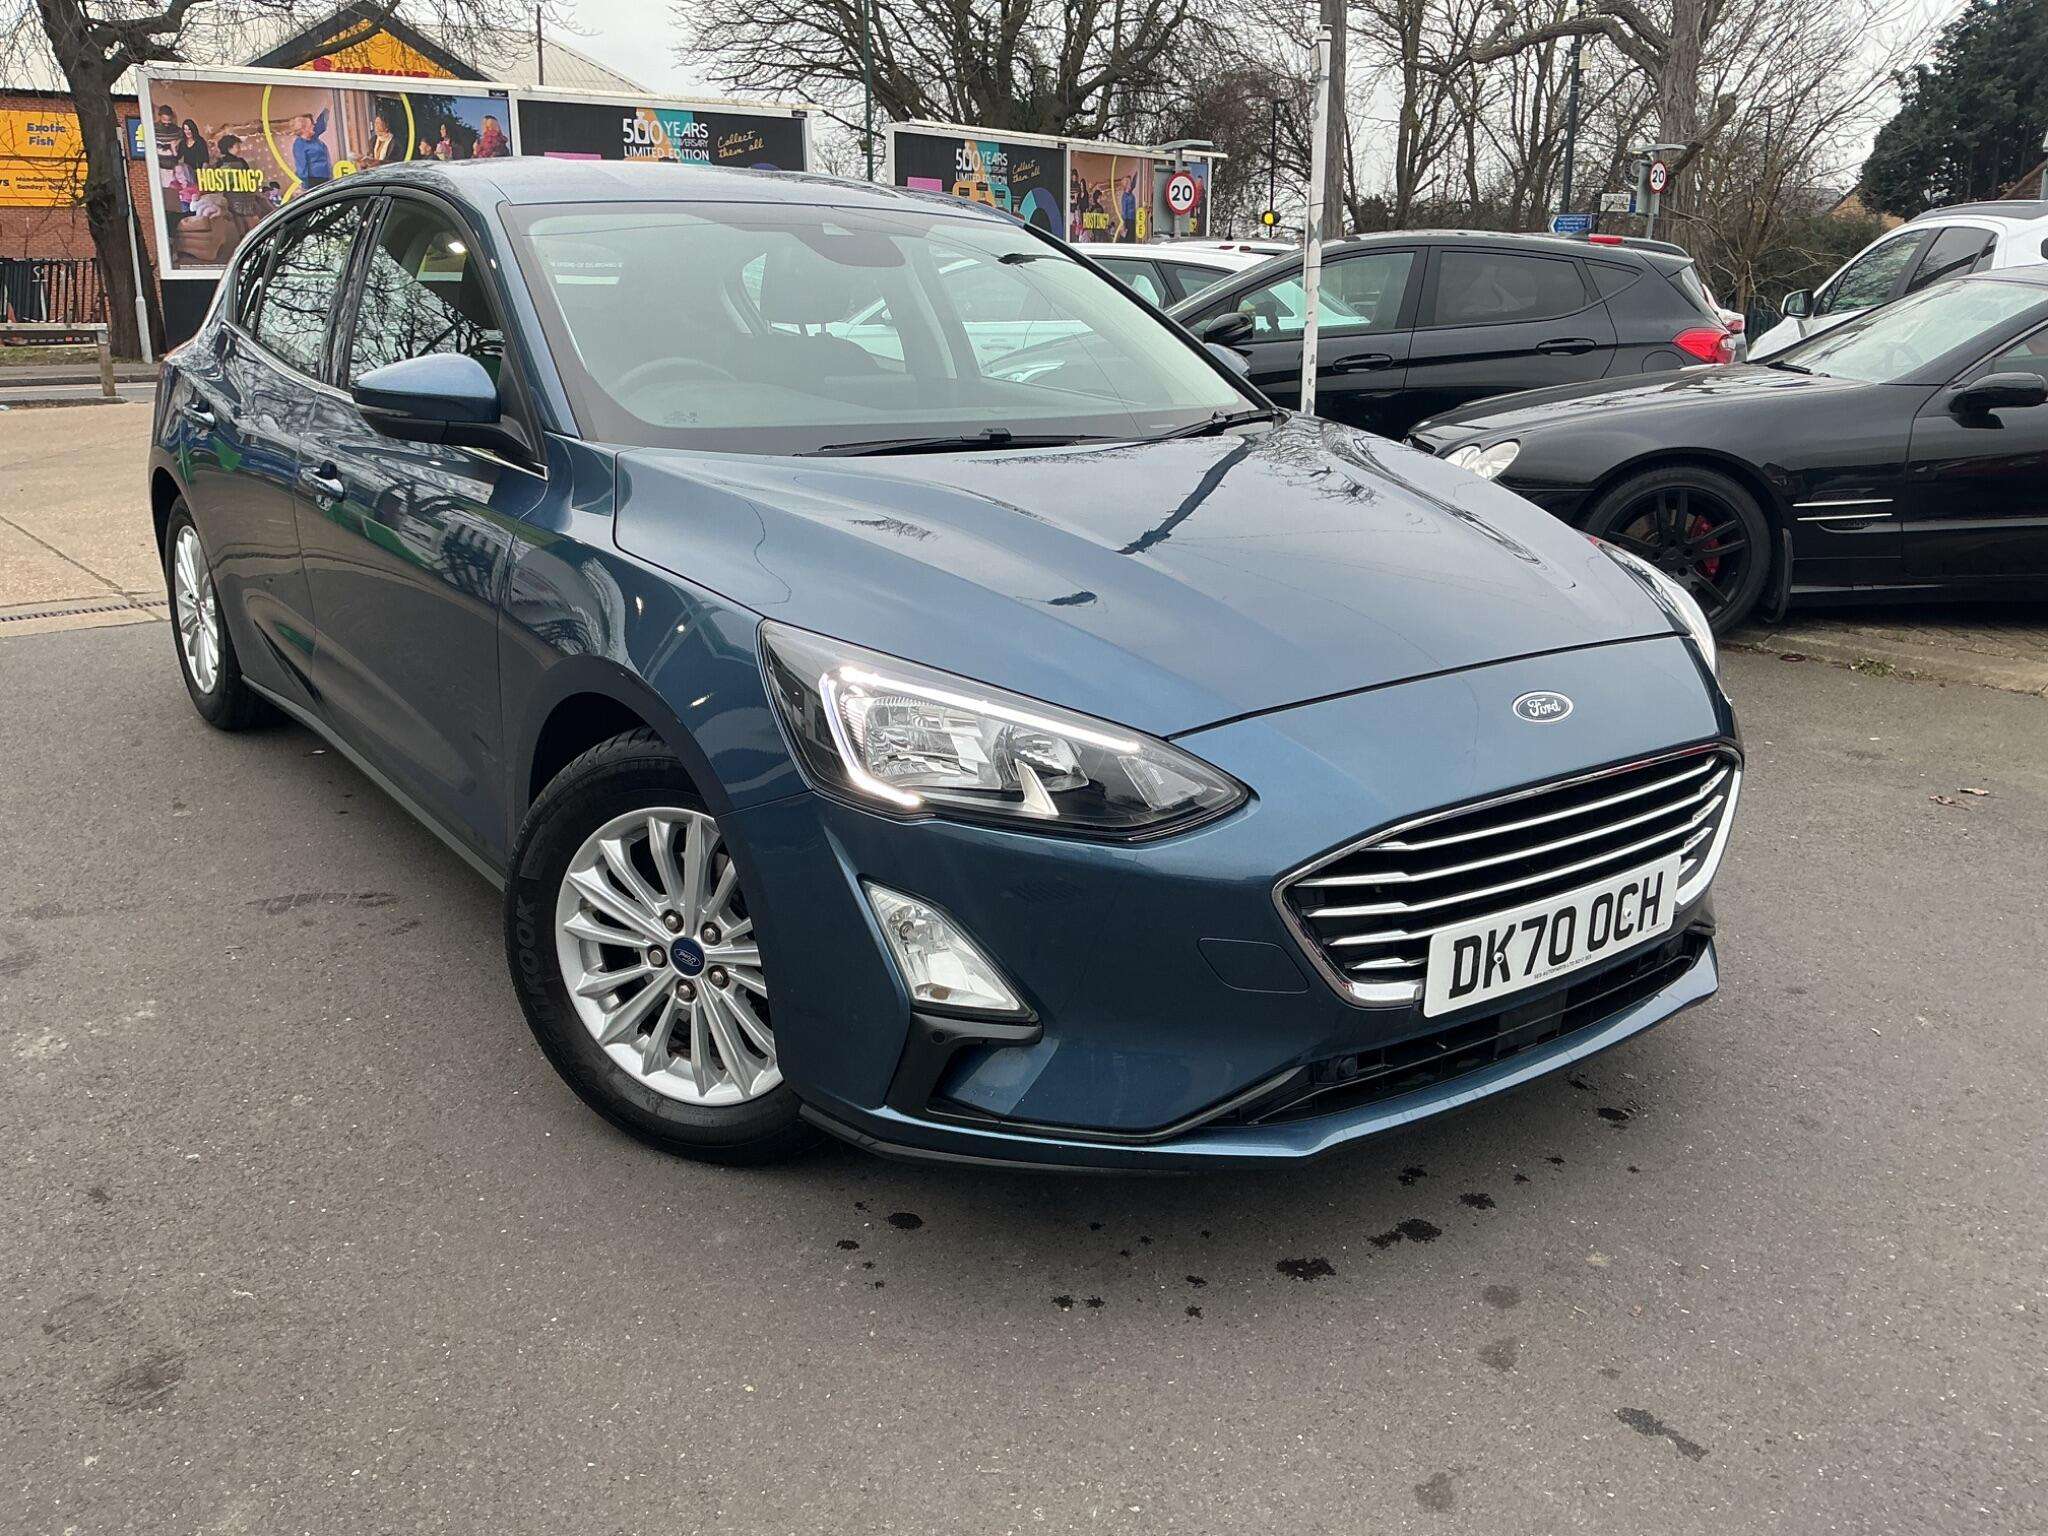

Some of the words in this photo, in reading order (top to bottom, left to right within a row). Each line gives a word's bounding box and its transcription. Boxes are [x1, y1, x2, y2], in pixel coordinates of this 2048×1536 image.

[27, 123, 66, 132] Exotic
[664, 121, 709, 139] YEARS
[28, 136, 54, 147] Fish
[717, 130, 756, 149] Collect
[624, 146, 665, 159] LIMITED
[669, 148, 710, 161] EDITION
[980, 151, 1008, 166] YEARS
[196, 168, 264, 193] HOSTING?
[1652, 170, 1665, 183] 20
[1171, 185, 1193, 202] 20
[1526, 697, 1562, 717] Ford
[1448, 905, 1578, 1000] DK70
[1586, 871, 1664, 952] OCH
